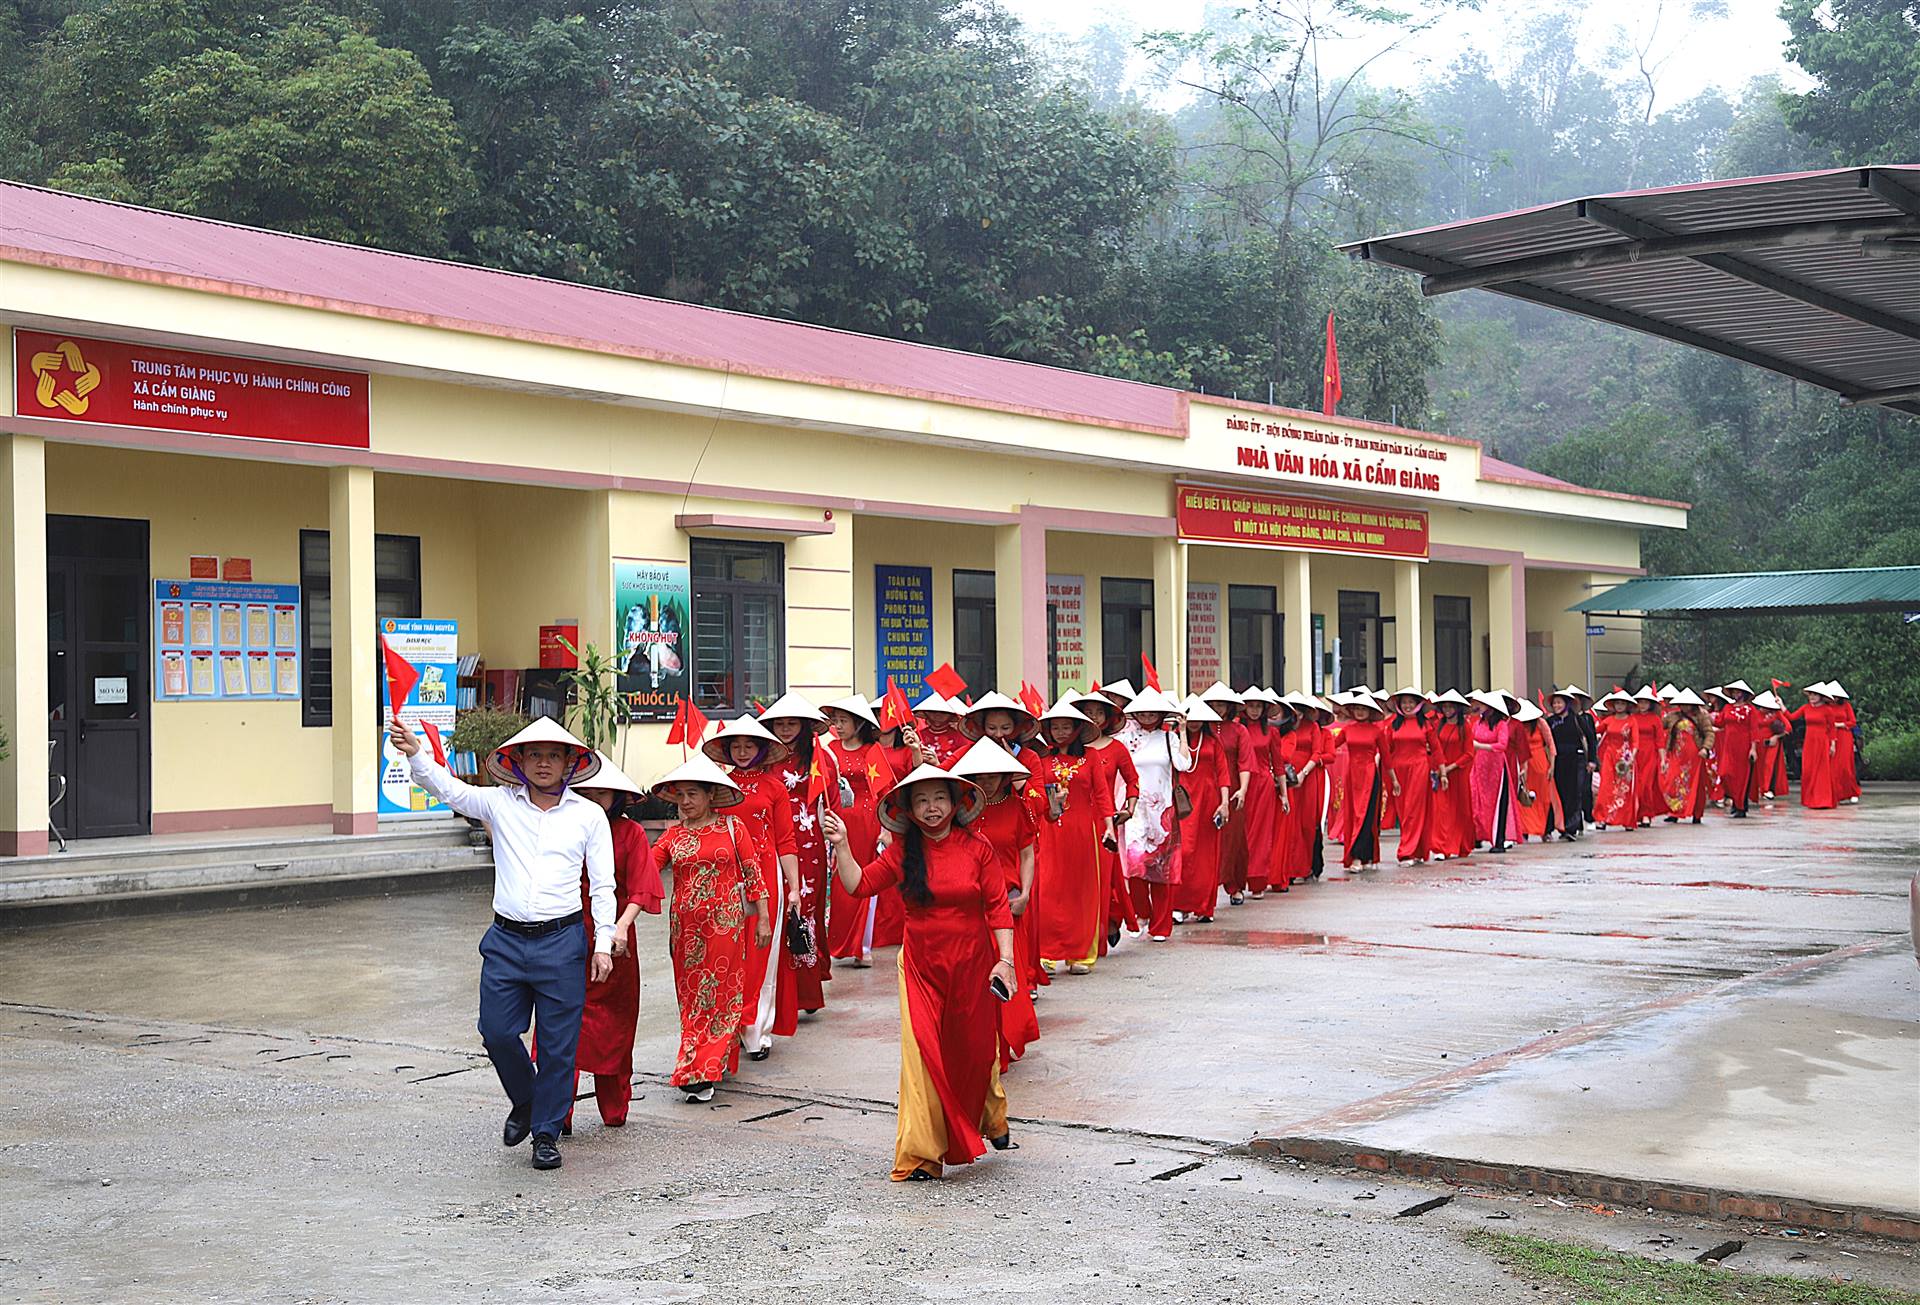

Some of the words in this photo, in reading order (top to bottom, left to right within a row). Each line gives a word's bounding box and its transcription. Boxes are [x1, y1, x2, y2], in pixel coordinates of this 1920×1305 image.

[132, 359, 171, 376] TRUNG
[173, 364, 196, 379] TÂM
[200, 369, 231, 385] PHỤC
[233, 372, 248, 388] VỤ
[253, 373, 283, 389] HÀNH
[286, 378, 319, 394] CHÍNH
[322, 381, 350, 397] CÔNG
[133, 380, 149, 395] XÃ
[152, 379, 177, 398] CẨM
[180, 386, 216, 402] GIÀNG
[133, 400, 159, 412] Hành
[161, 403, 188, 414] chính
[190, 406, 214, 419] phục
[216, 410, 227, 421] vụ
[1355, 439, 1368, 449] BAN
[1238, 445, 1269, 469] NHÀ
[1275, 449, 1303, 474] VĂN
[1310, 454, 1338, 478] HÓA
[1343, 458, 1362, 481] XÃ
[1366, 458, 1396, 486] CẨM
[1400, 467, 1440, 491] GIÀNG
[629, 630, 659, 643] KHÔNG
[661, 631, 678, 644] HÚT
[627, 689, 665, 705] THUỐC
[667, 690, 680, 705] LÁ
